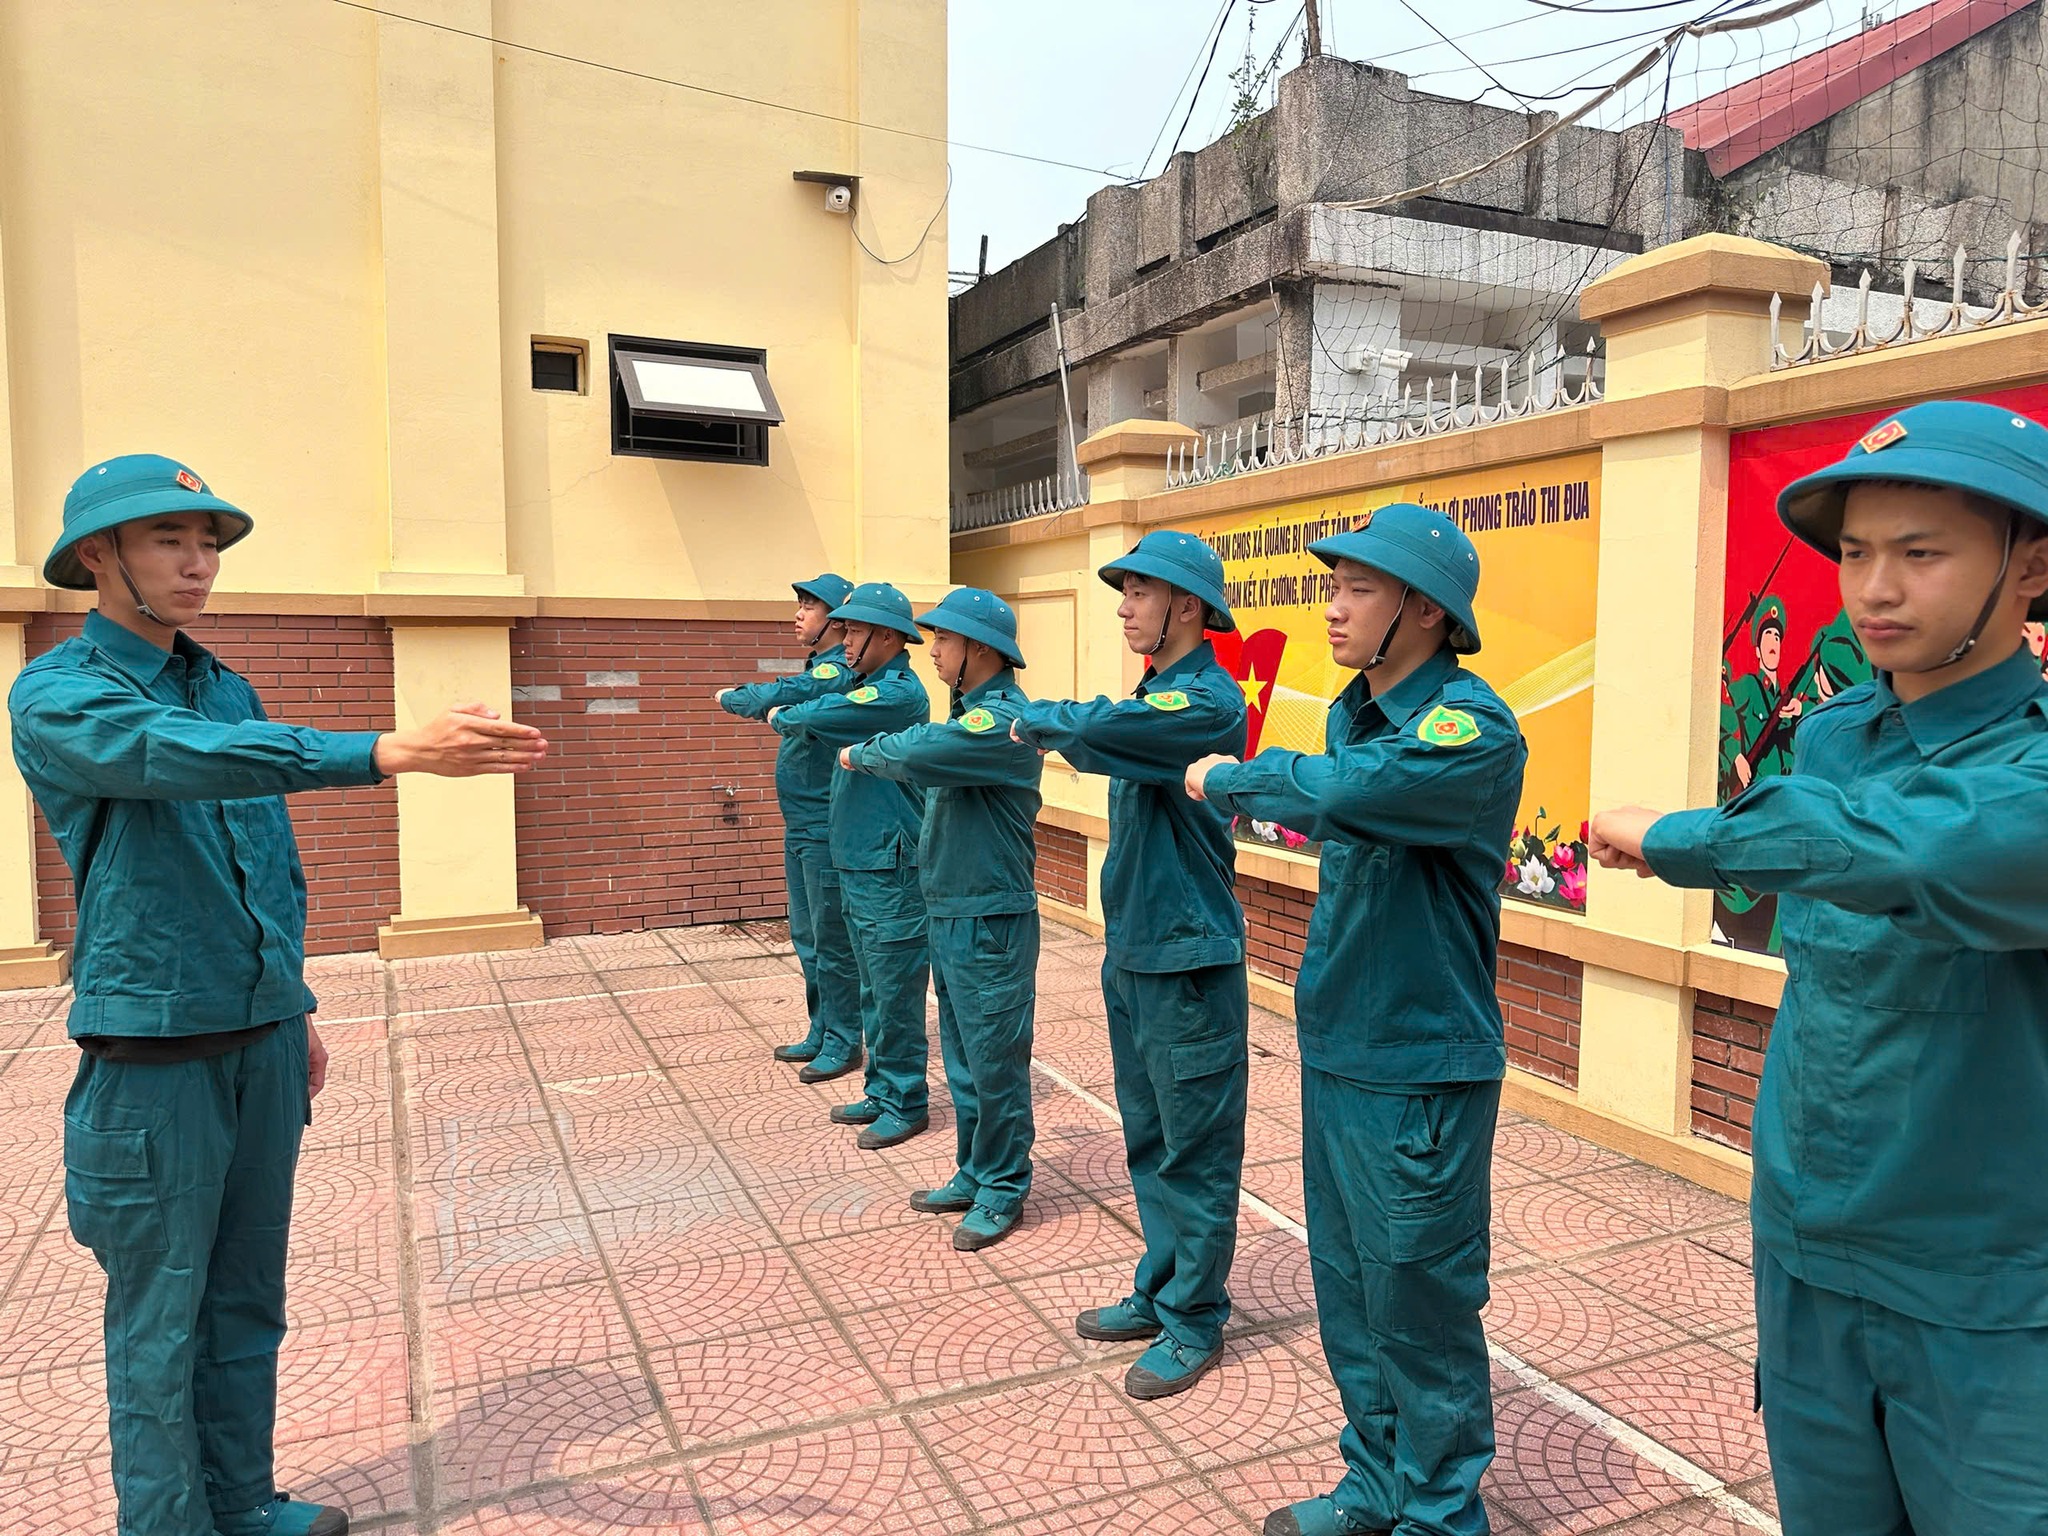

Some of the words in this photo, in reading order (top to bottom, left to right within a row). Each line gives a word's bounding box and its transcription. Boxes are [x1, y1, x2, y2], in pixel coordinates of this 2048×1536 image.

[1232, 531, 1251, 562] CHQS
[1252, 524, 1263, 558] XÃ
[1264, 516, 1291, 560] QUẢNG
[1292, 523, 1301, 560] BỊ
[1302, 509, 1329, 556] QUYẾT
[1331, 510, 1350, 537] TÂM
[1462, 493, 1502, 534] PHONG
[1505, 482, 1537, 528] TRÀO
[1540, 484, 1560, 524] THI
[1563, 480, 1590, 522] ĐUA
[1242, 571, 1258, 611] KẾT,
[1270, 574, 1300, 608] CƯƠNG,
[1301, 568, 1318, 611] ĐỘT
